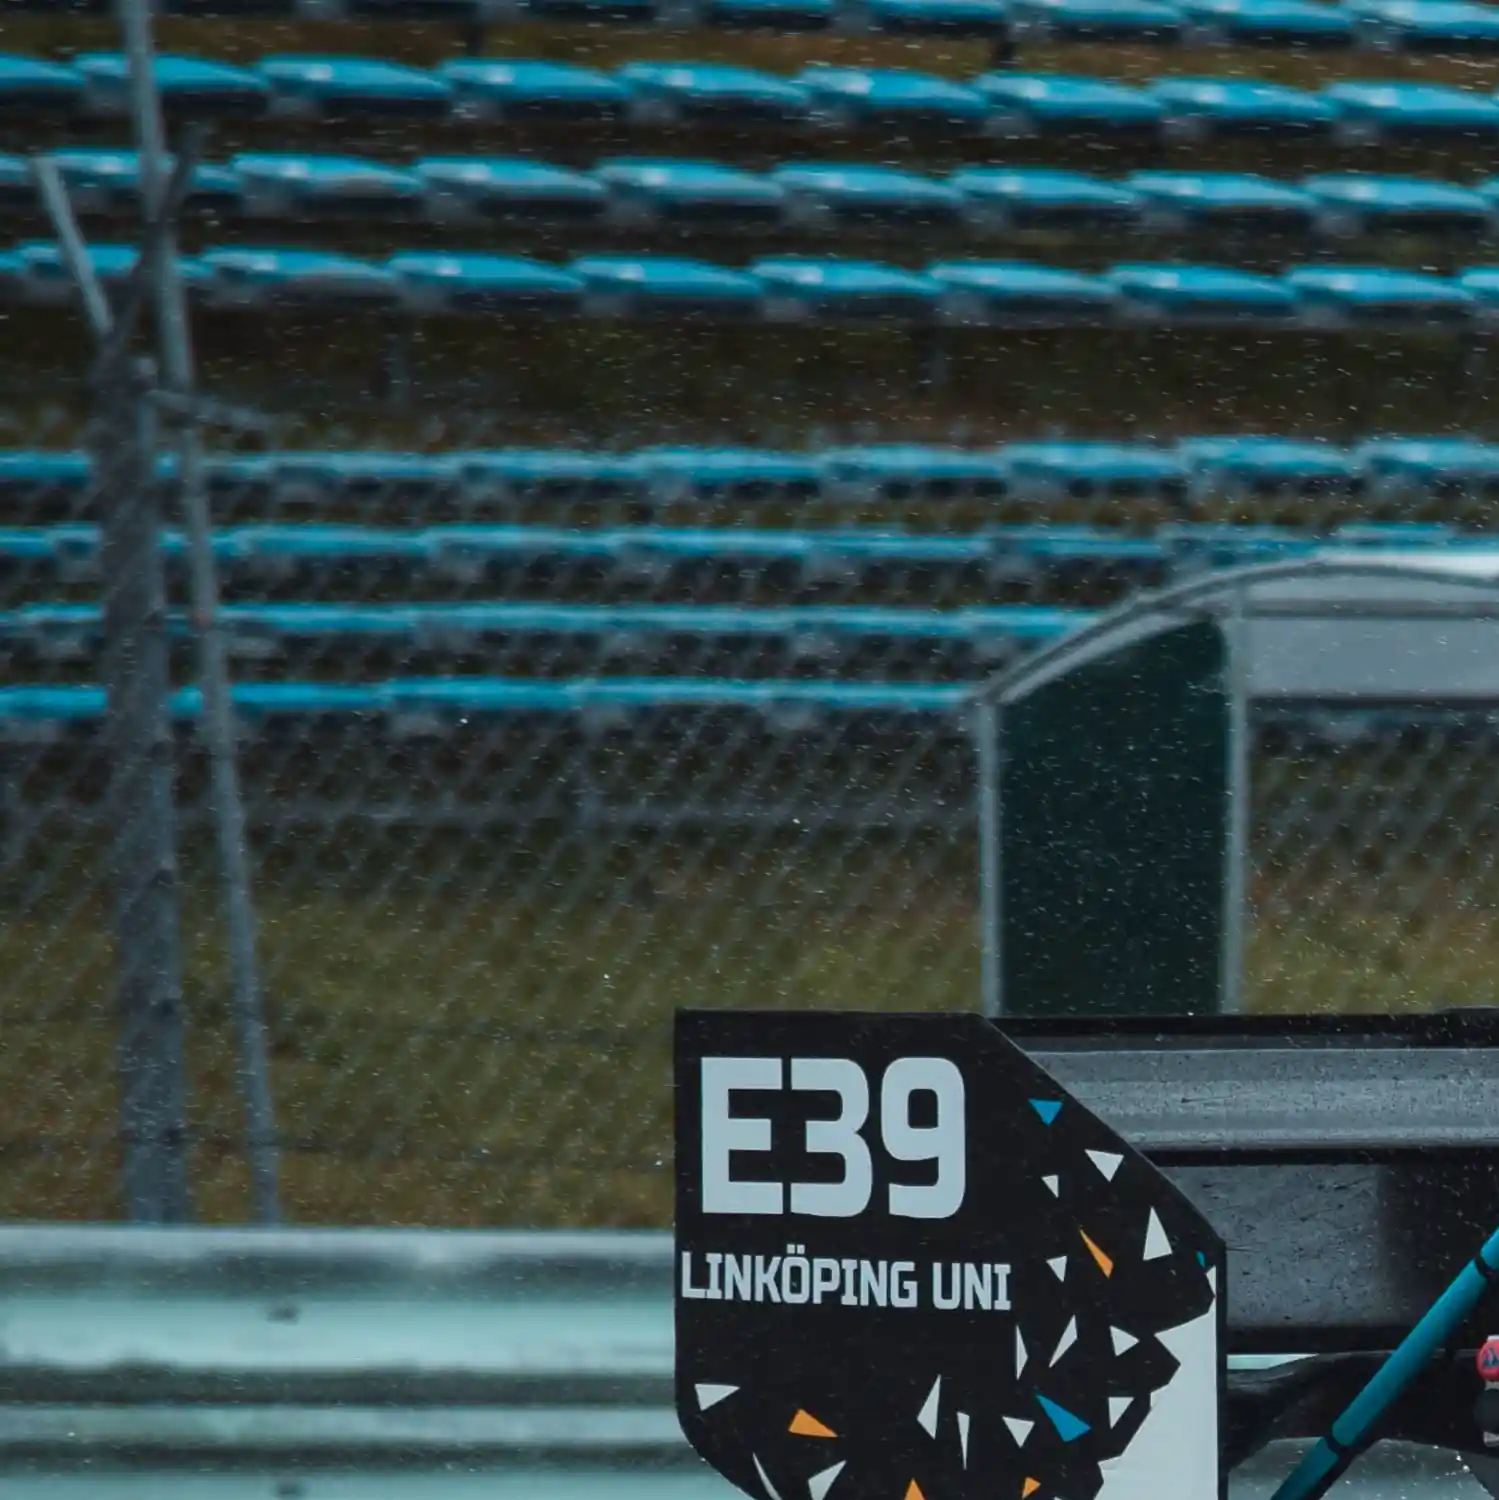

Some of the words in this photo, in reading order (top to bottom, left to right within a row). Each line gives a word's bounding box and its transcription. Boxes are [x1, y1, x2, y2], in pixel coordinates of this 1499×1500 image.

[701, 1056, 966, 1219] E39
[681, 1244, 917, 1309] LINKÖPING
[932, 1262, 1011, 1311] UNI
